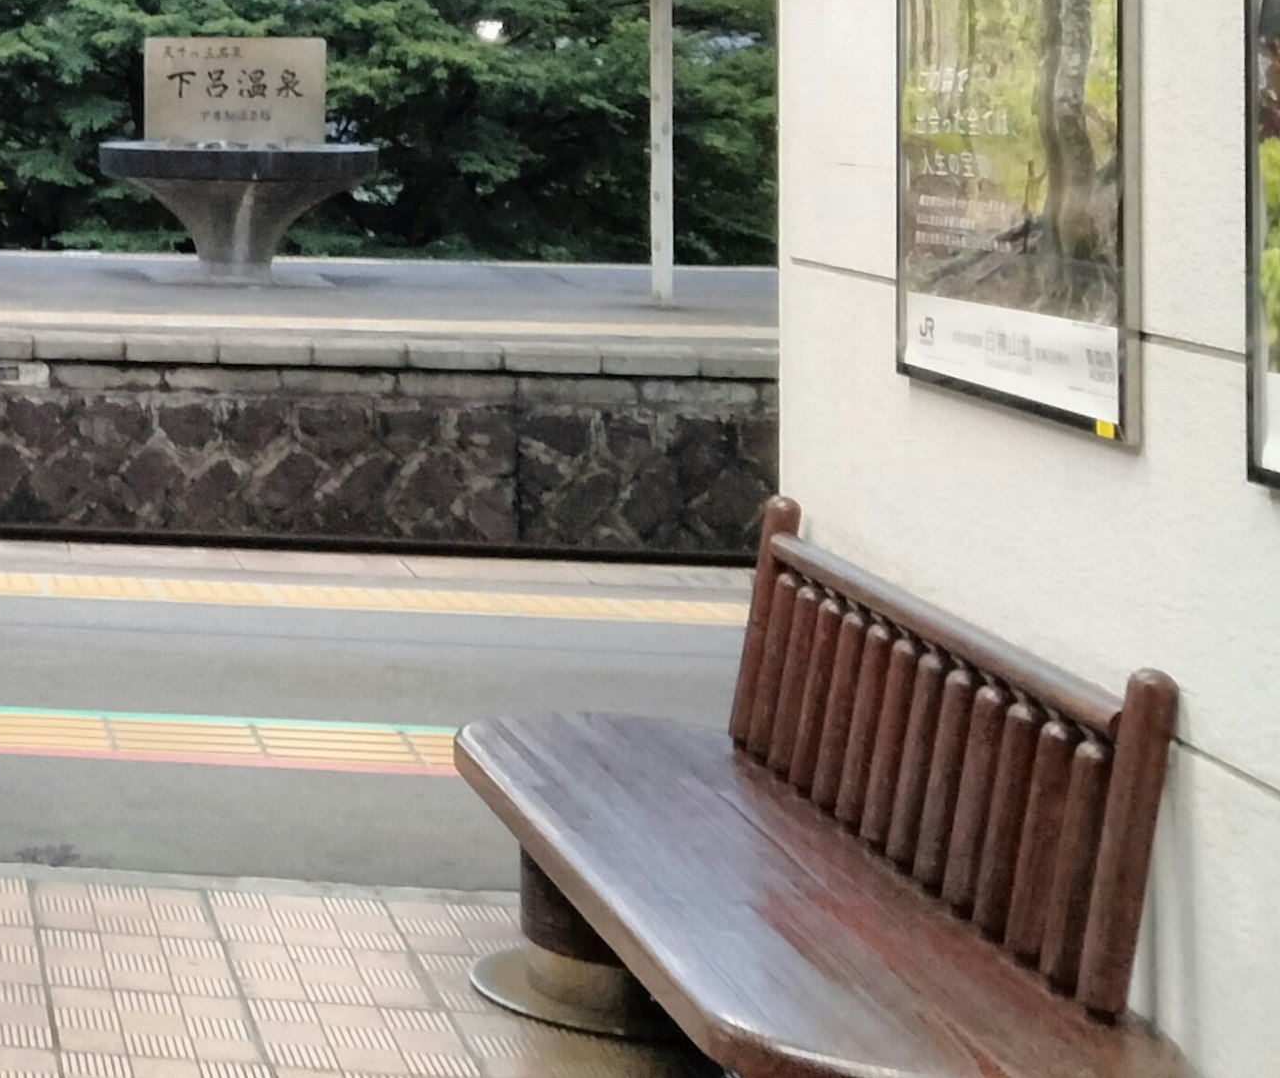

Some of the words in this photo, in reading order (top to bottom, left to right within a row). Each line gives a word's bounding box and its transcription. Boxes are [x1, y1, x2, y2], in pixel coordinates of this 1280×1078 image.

[166, 68, 304, 99] 下呂温泉
[917, 67, 969, 93] この森で
[919, 316, 935, 340] JR
